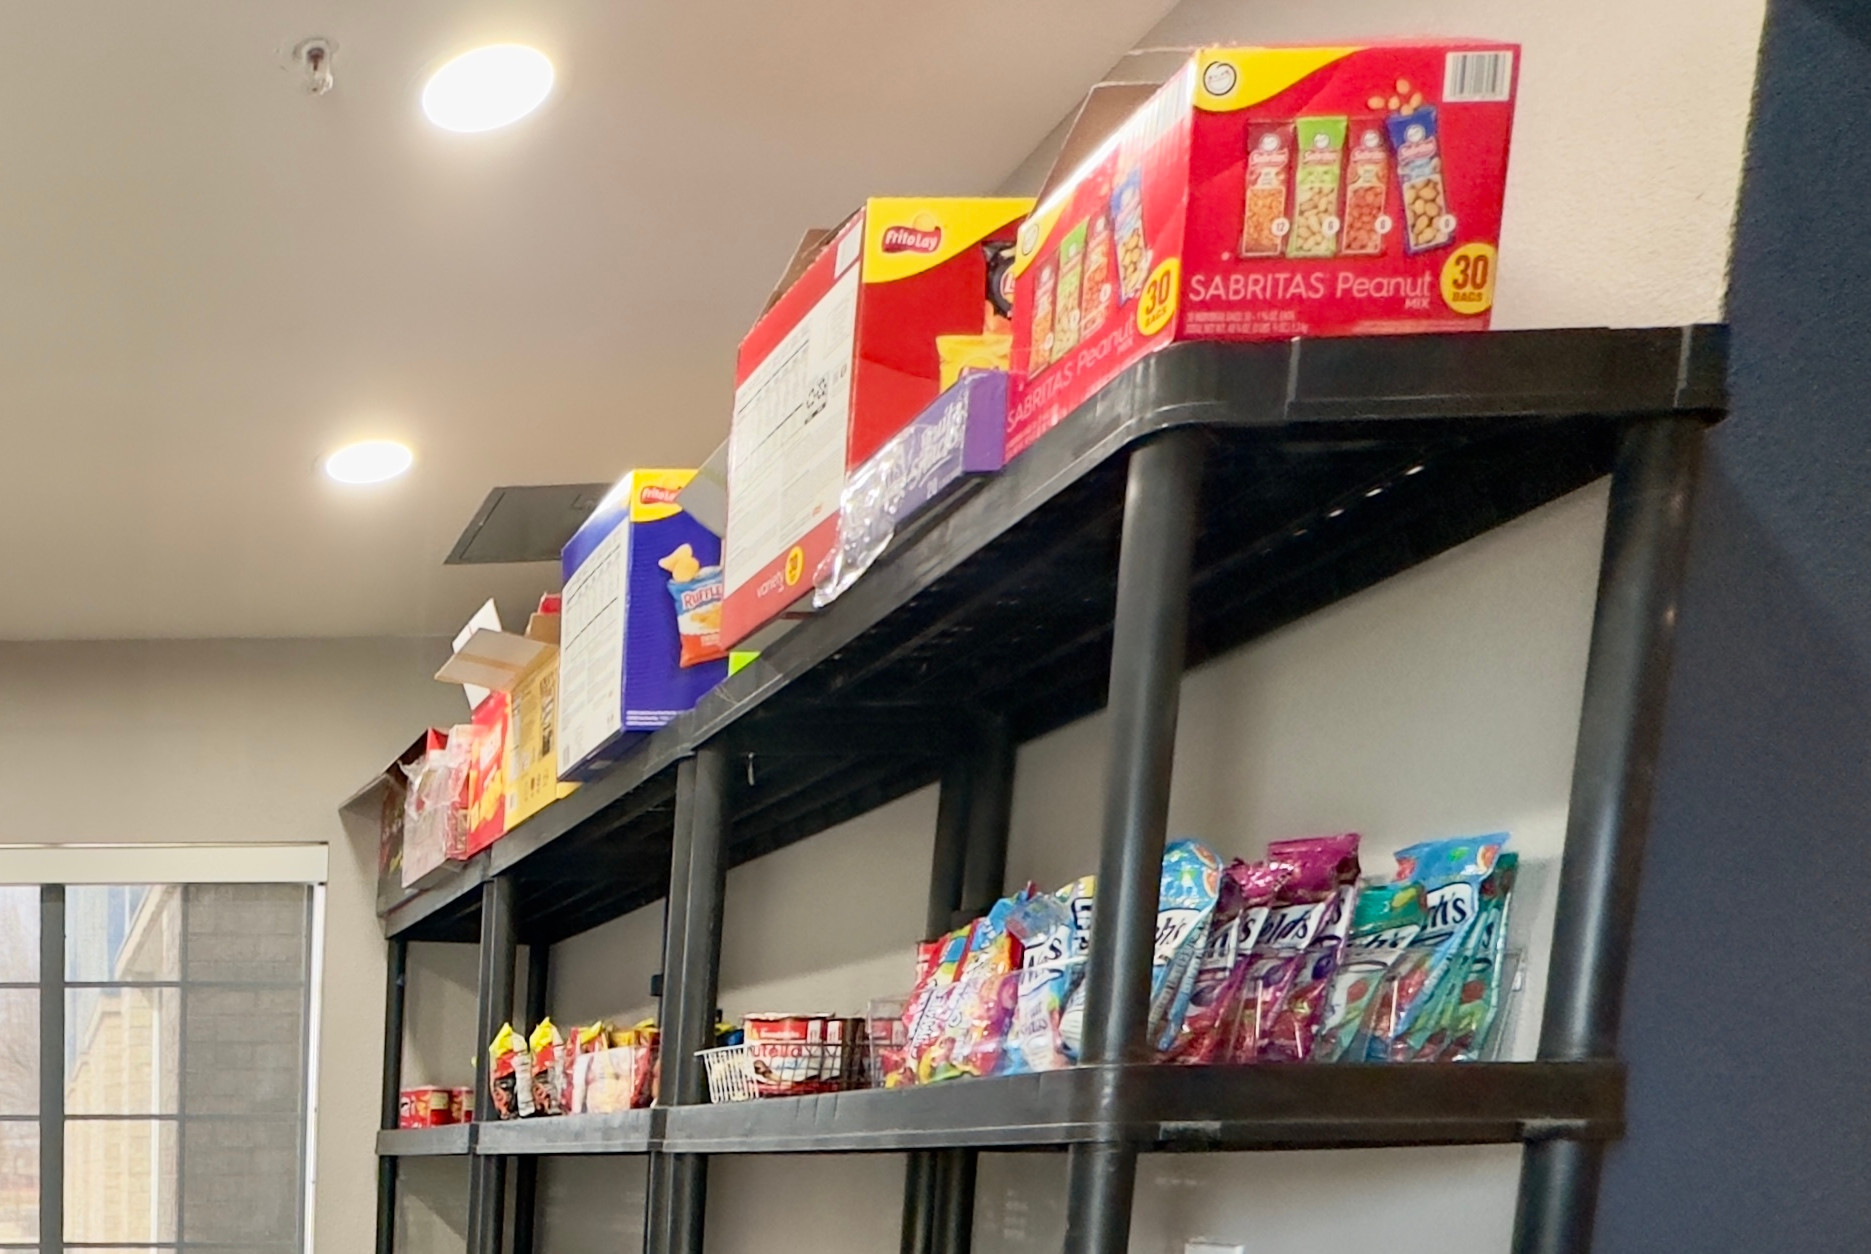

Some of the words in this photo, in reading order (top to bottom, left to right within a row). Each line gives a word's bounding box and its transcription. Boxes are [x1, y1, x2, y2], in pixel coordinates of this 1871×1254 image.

[1188, 272, 1326, 301] SABRITAS
[1335, 270, 1433, 299] Peanut
[1451, 253, 1489, 291] 30
[1145, 269, 1173, 314] 30
[1404, 298, 1432, 310] MIX
[1452, 290, 1484, 303] BAGS
[1006, 362, 1073, 433] SABRITAS
[1076, 315, 1137, 376] Peanut
[682, 583, 724, 610] RUFFLE
